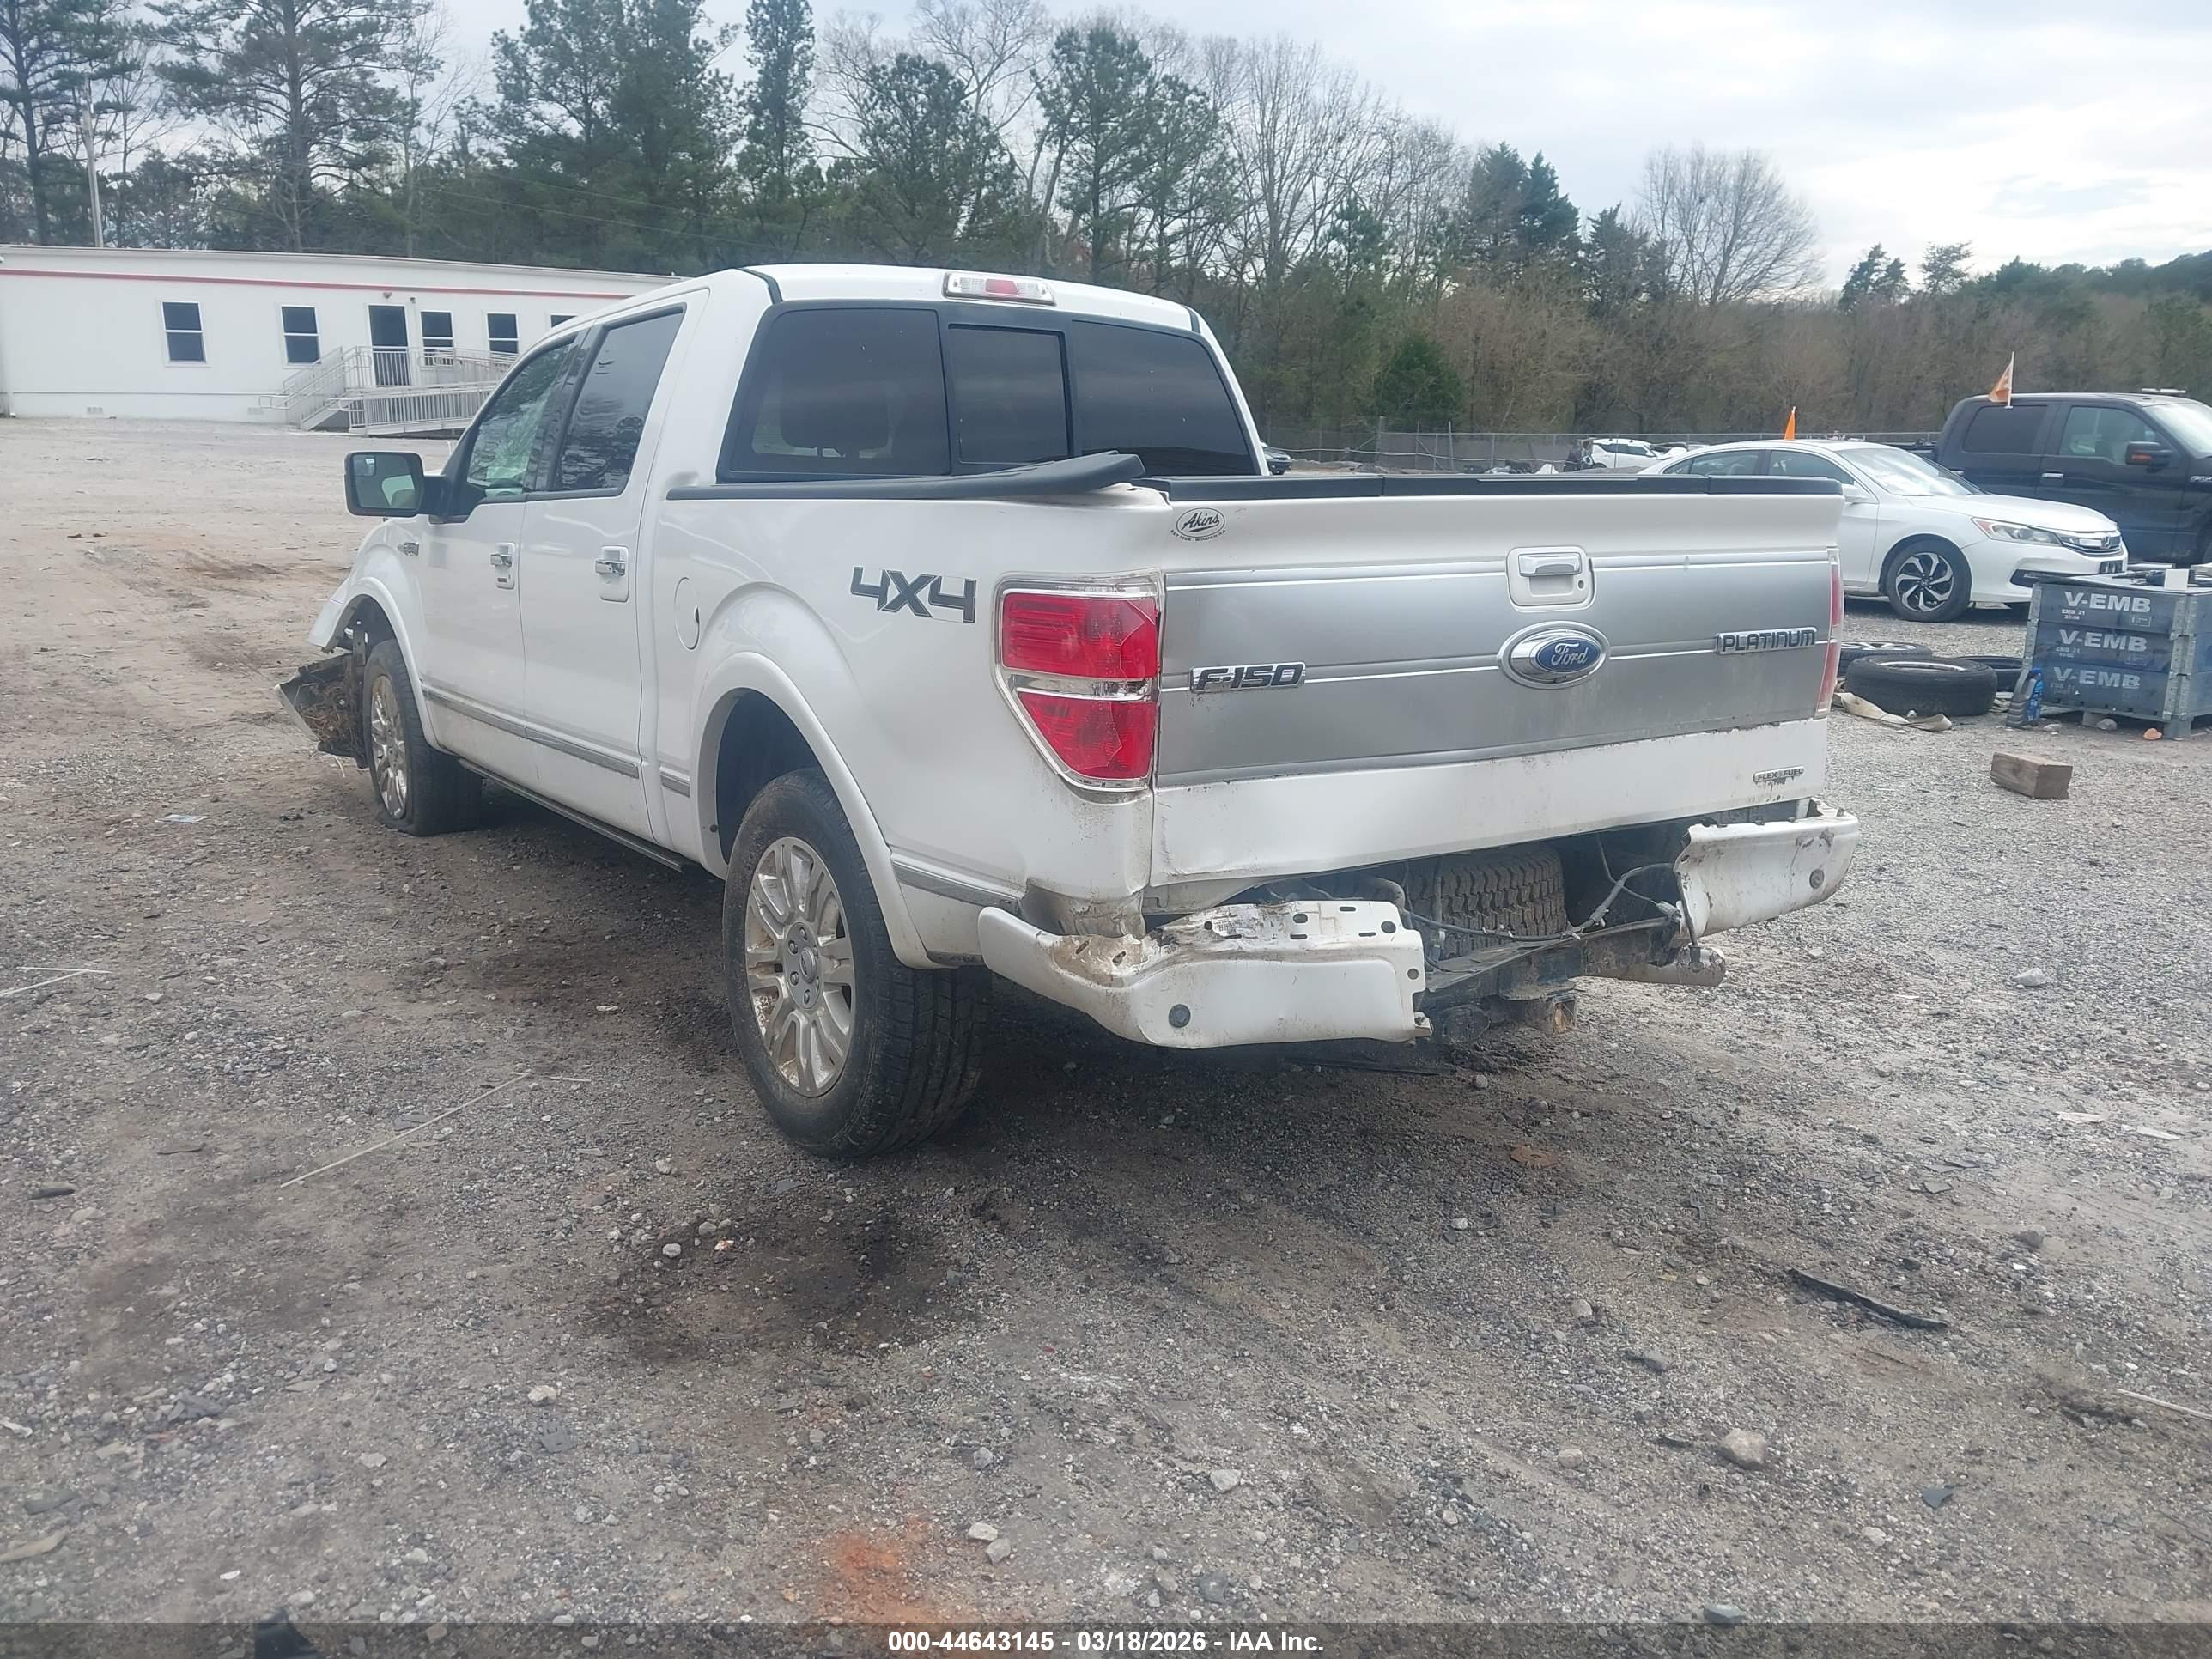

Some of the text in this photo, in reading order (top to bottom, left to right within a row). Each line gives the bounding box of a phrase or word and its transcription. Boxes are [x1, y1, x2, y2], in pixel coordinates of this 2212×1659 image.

[1180, 512, 1220, 531] Akins
[850, 566, 976, 623] 4X4
[2064, 591, 2151, 613] V-EMB
[1722, 629, 1815, 653] PLATINUM
[2059, 629, 2147, 652] V-EMB
[1551, 642, 1589, 666] Ford
[1194, 664, 1304, 691] F-150
[2053, 666, 2141, 690] V-EMB
